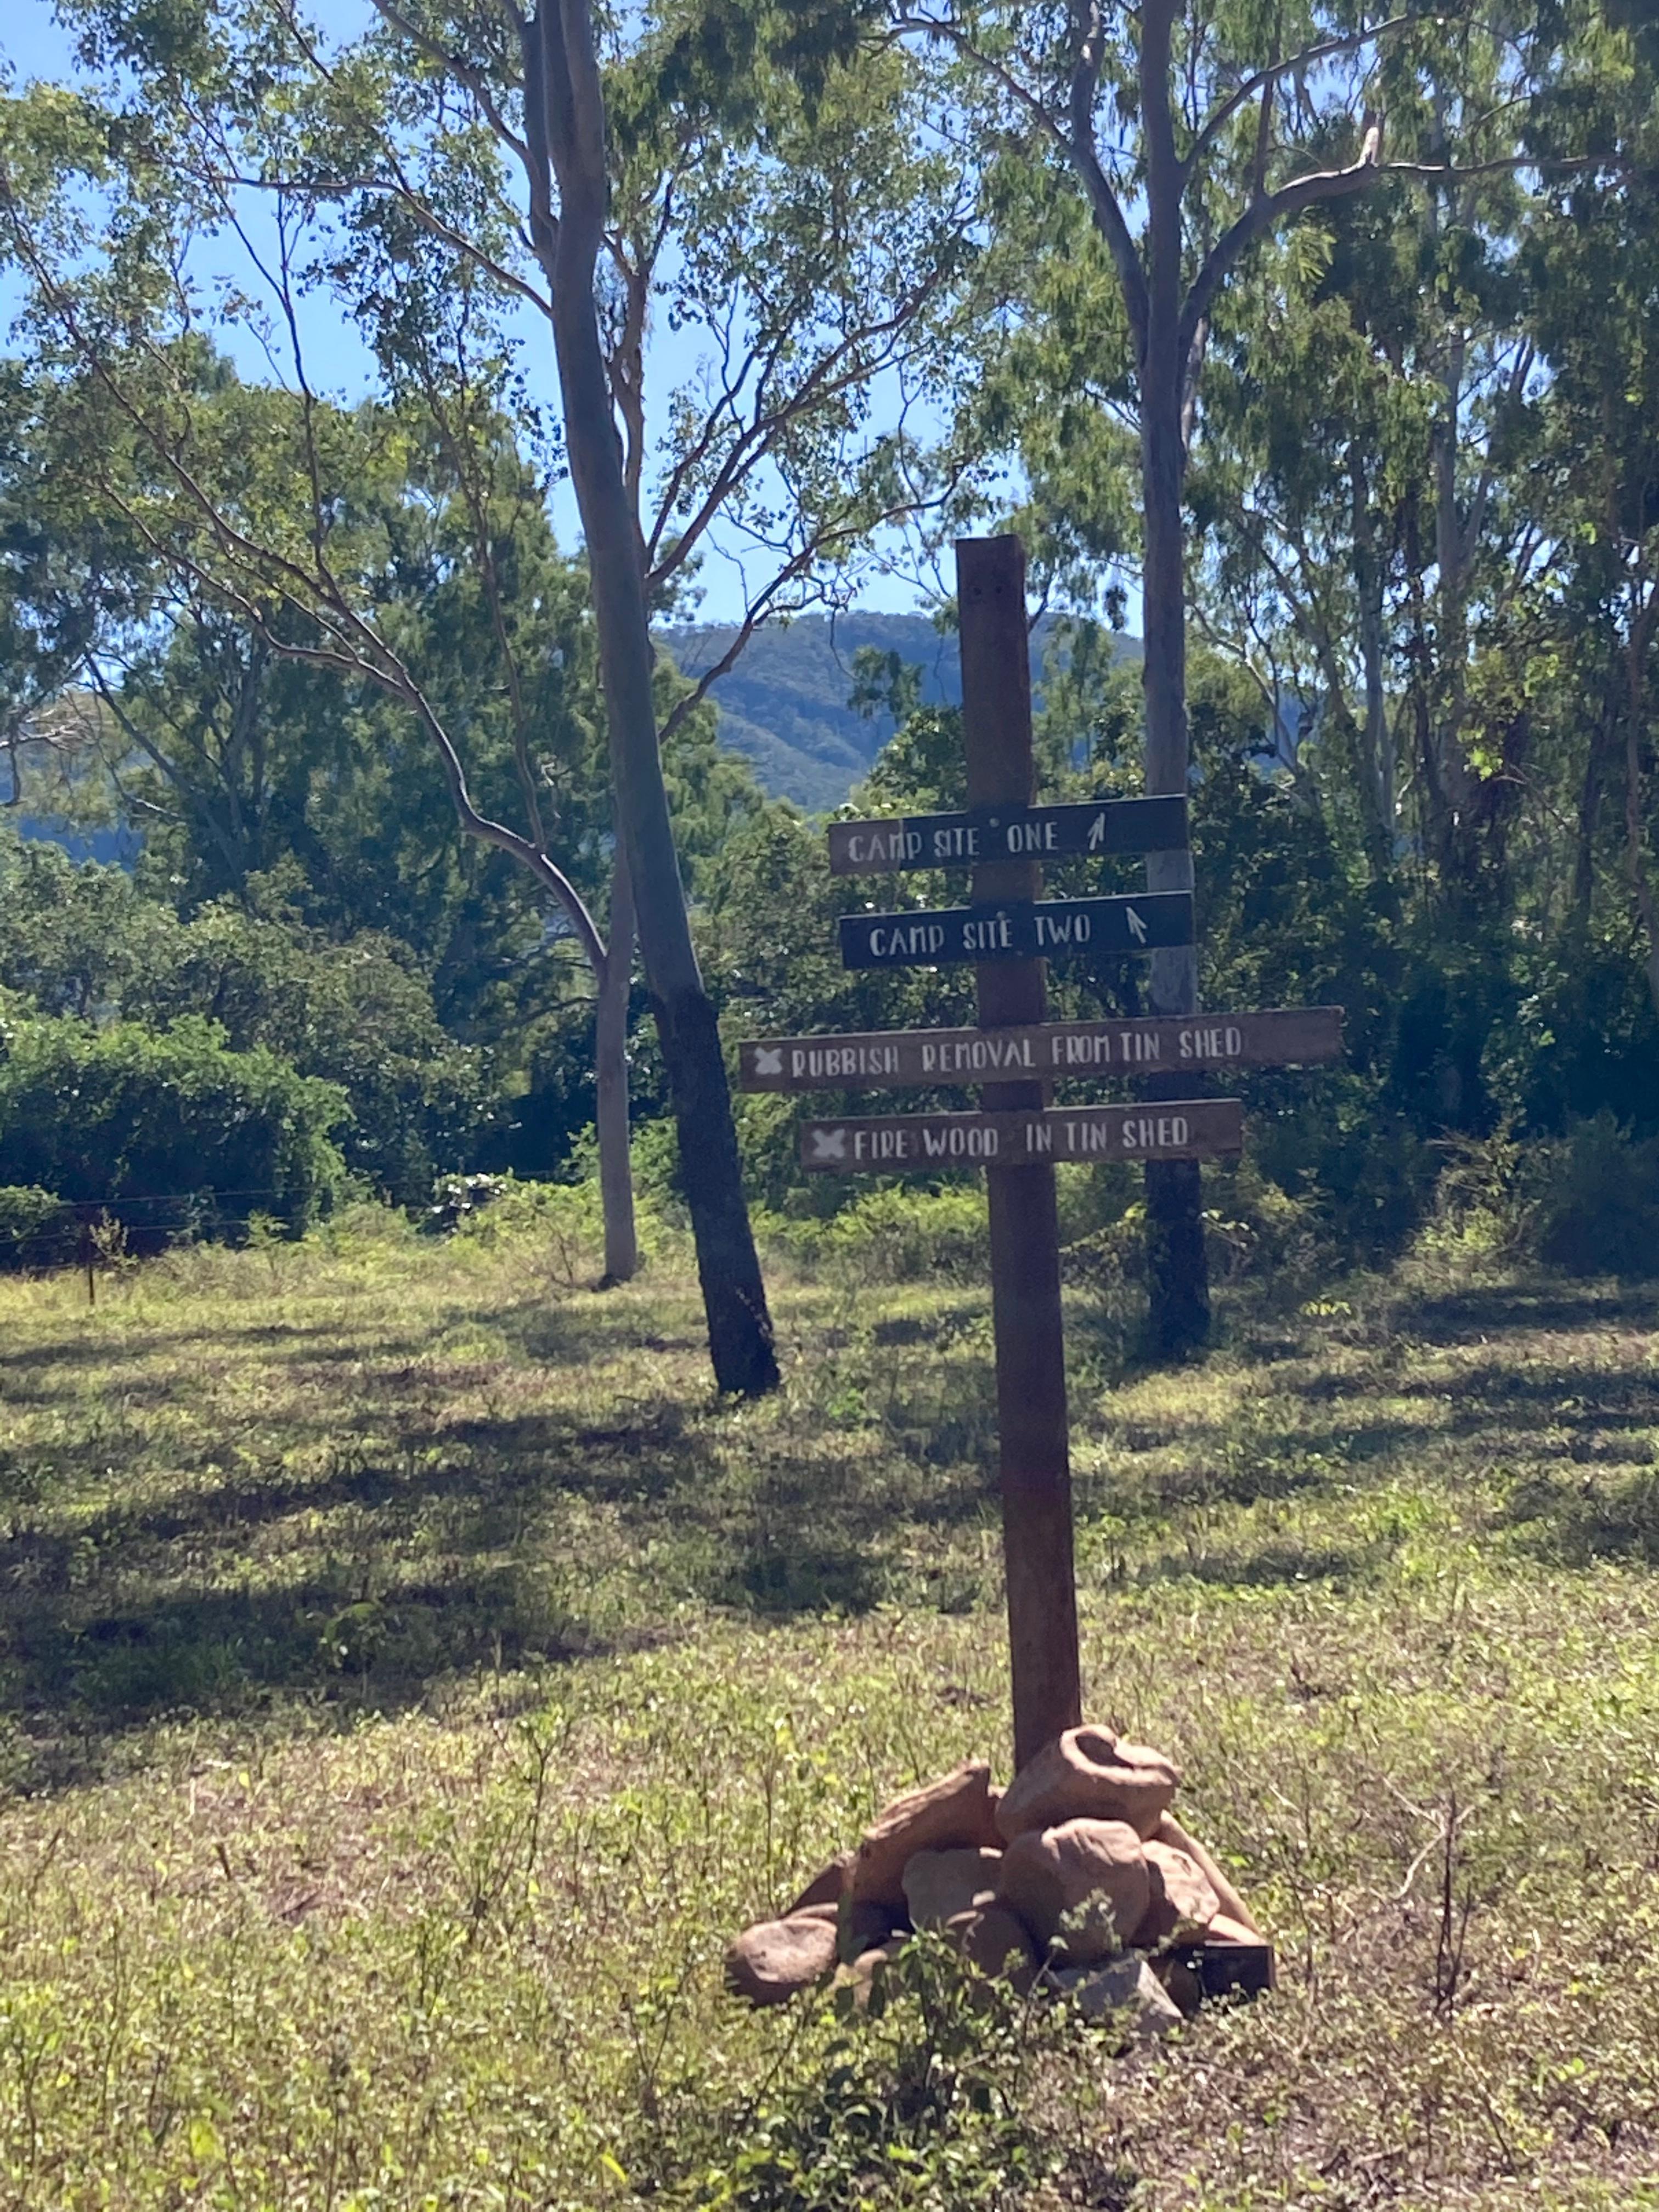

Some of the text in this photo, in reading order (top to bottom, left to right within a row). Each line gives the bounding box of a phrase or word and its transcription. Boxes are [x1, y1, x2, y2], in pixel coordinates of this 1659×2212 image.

[848, 822, 1058, 862] CAMP SITE ONE
[870, 915, 1091, 957] CAMP SITE TWO
[792, 1027, 1242, 1078] RUBBISH REMOVAL FROM TIN SHED
[854, 1117, 1188, 1160] FIRE WOOD IN TIN SHED
